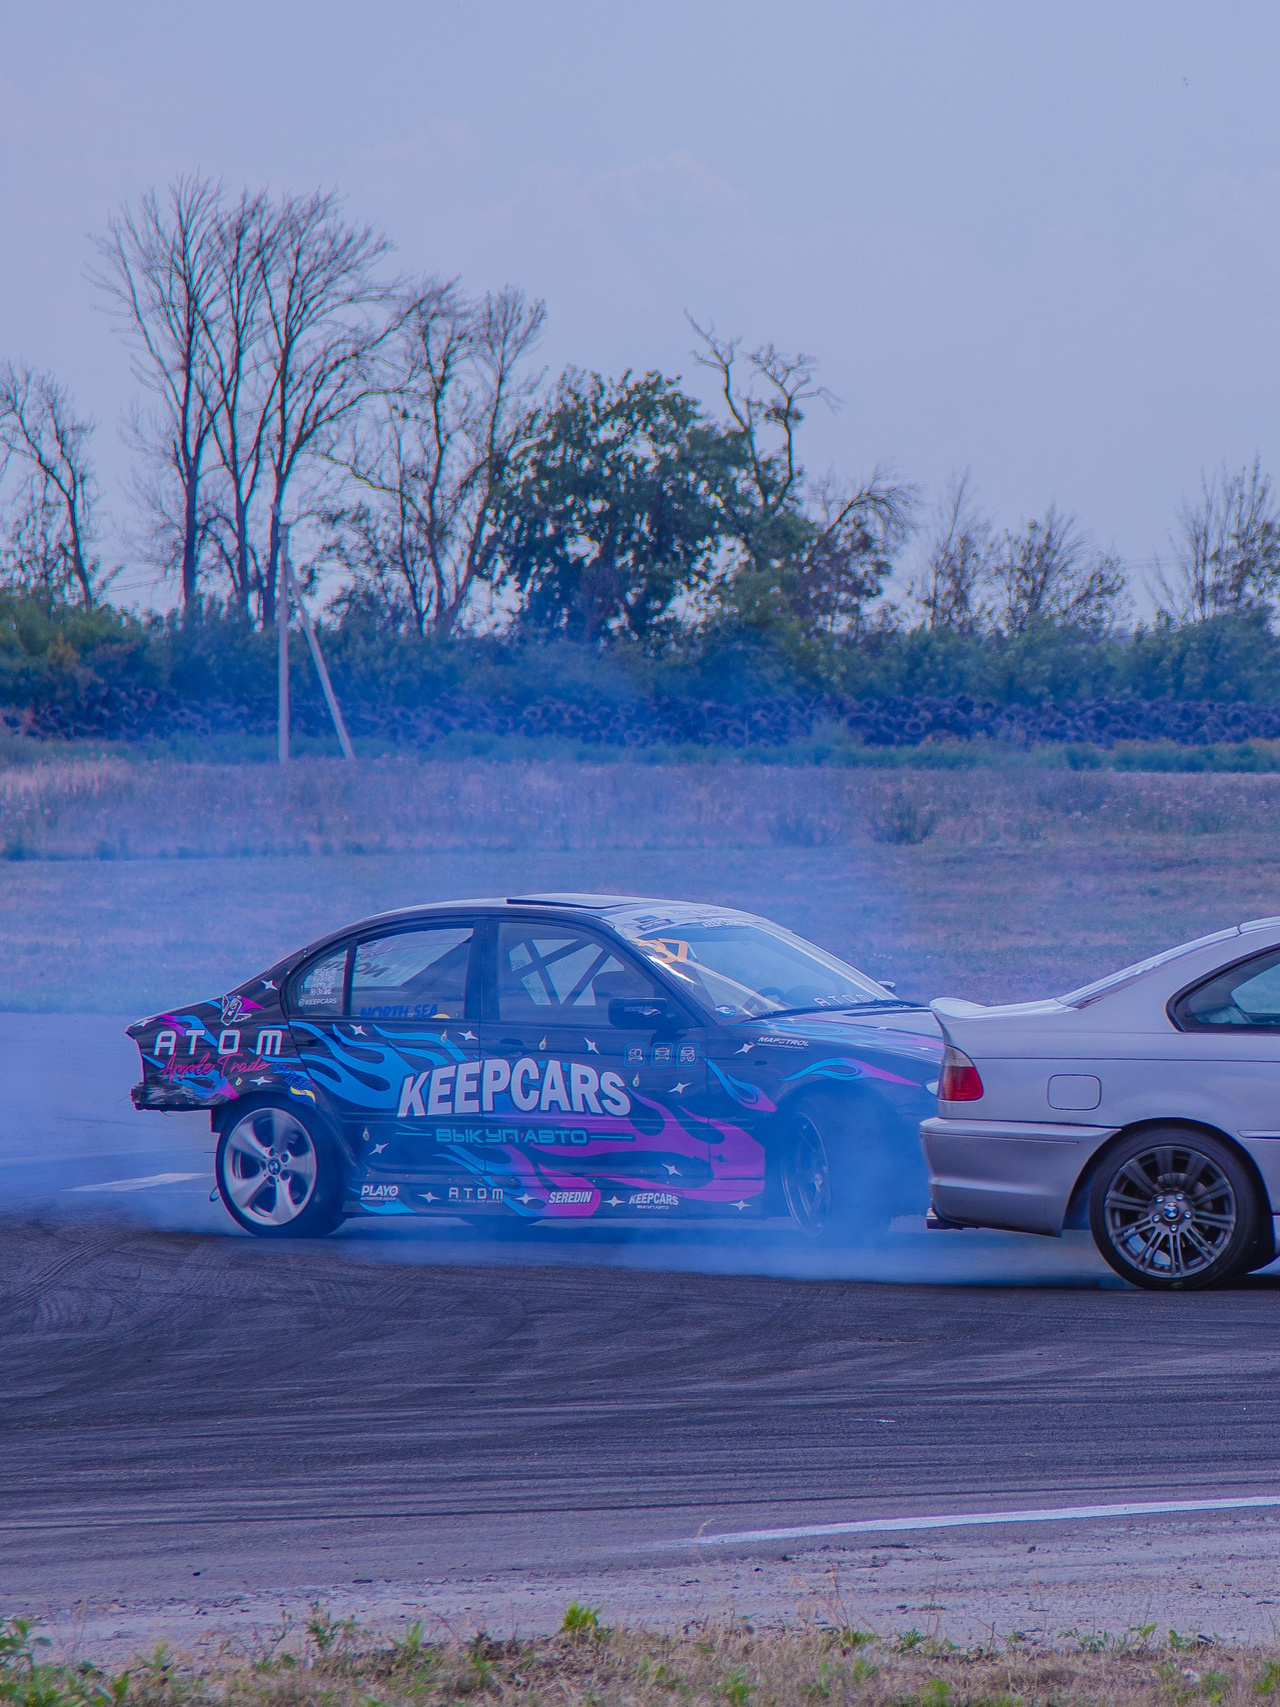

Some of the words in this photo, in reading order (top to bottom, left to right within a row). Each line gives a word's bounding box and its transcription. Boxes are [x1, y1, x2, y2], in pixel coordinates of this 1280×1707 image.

[636, 937, 688, 963] 37
[813, 994, 872, 1007] ATOM
[360, 1005, 410, 1017] NORTH
[413, 1003, 438, 1017] SEA
[154, 1029, 283, 1056] ATOM
[757, 1036, 809, 1047] MAPETROL
[159, 1053, 216, 1083] Apple
[217, 1053, 272, 1078] Trade
[396, 1057, 631, 1118] KEEPCARS
[435, 1128, 519, 1144] ВЫКУП
[523, 1129, 587, 1144] АВТО
[361, 1185, 399, 1197] PLAYO
[449, 1187, 504, 1200] ATOM
[549, 1191, 593, 1204] SEREDIN
[628, 1192, 679, 1206] KEEPCARS
